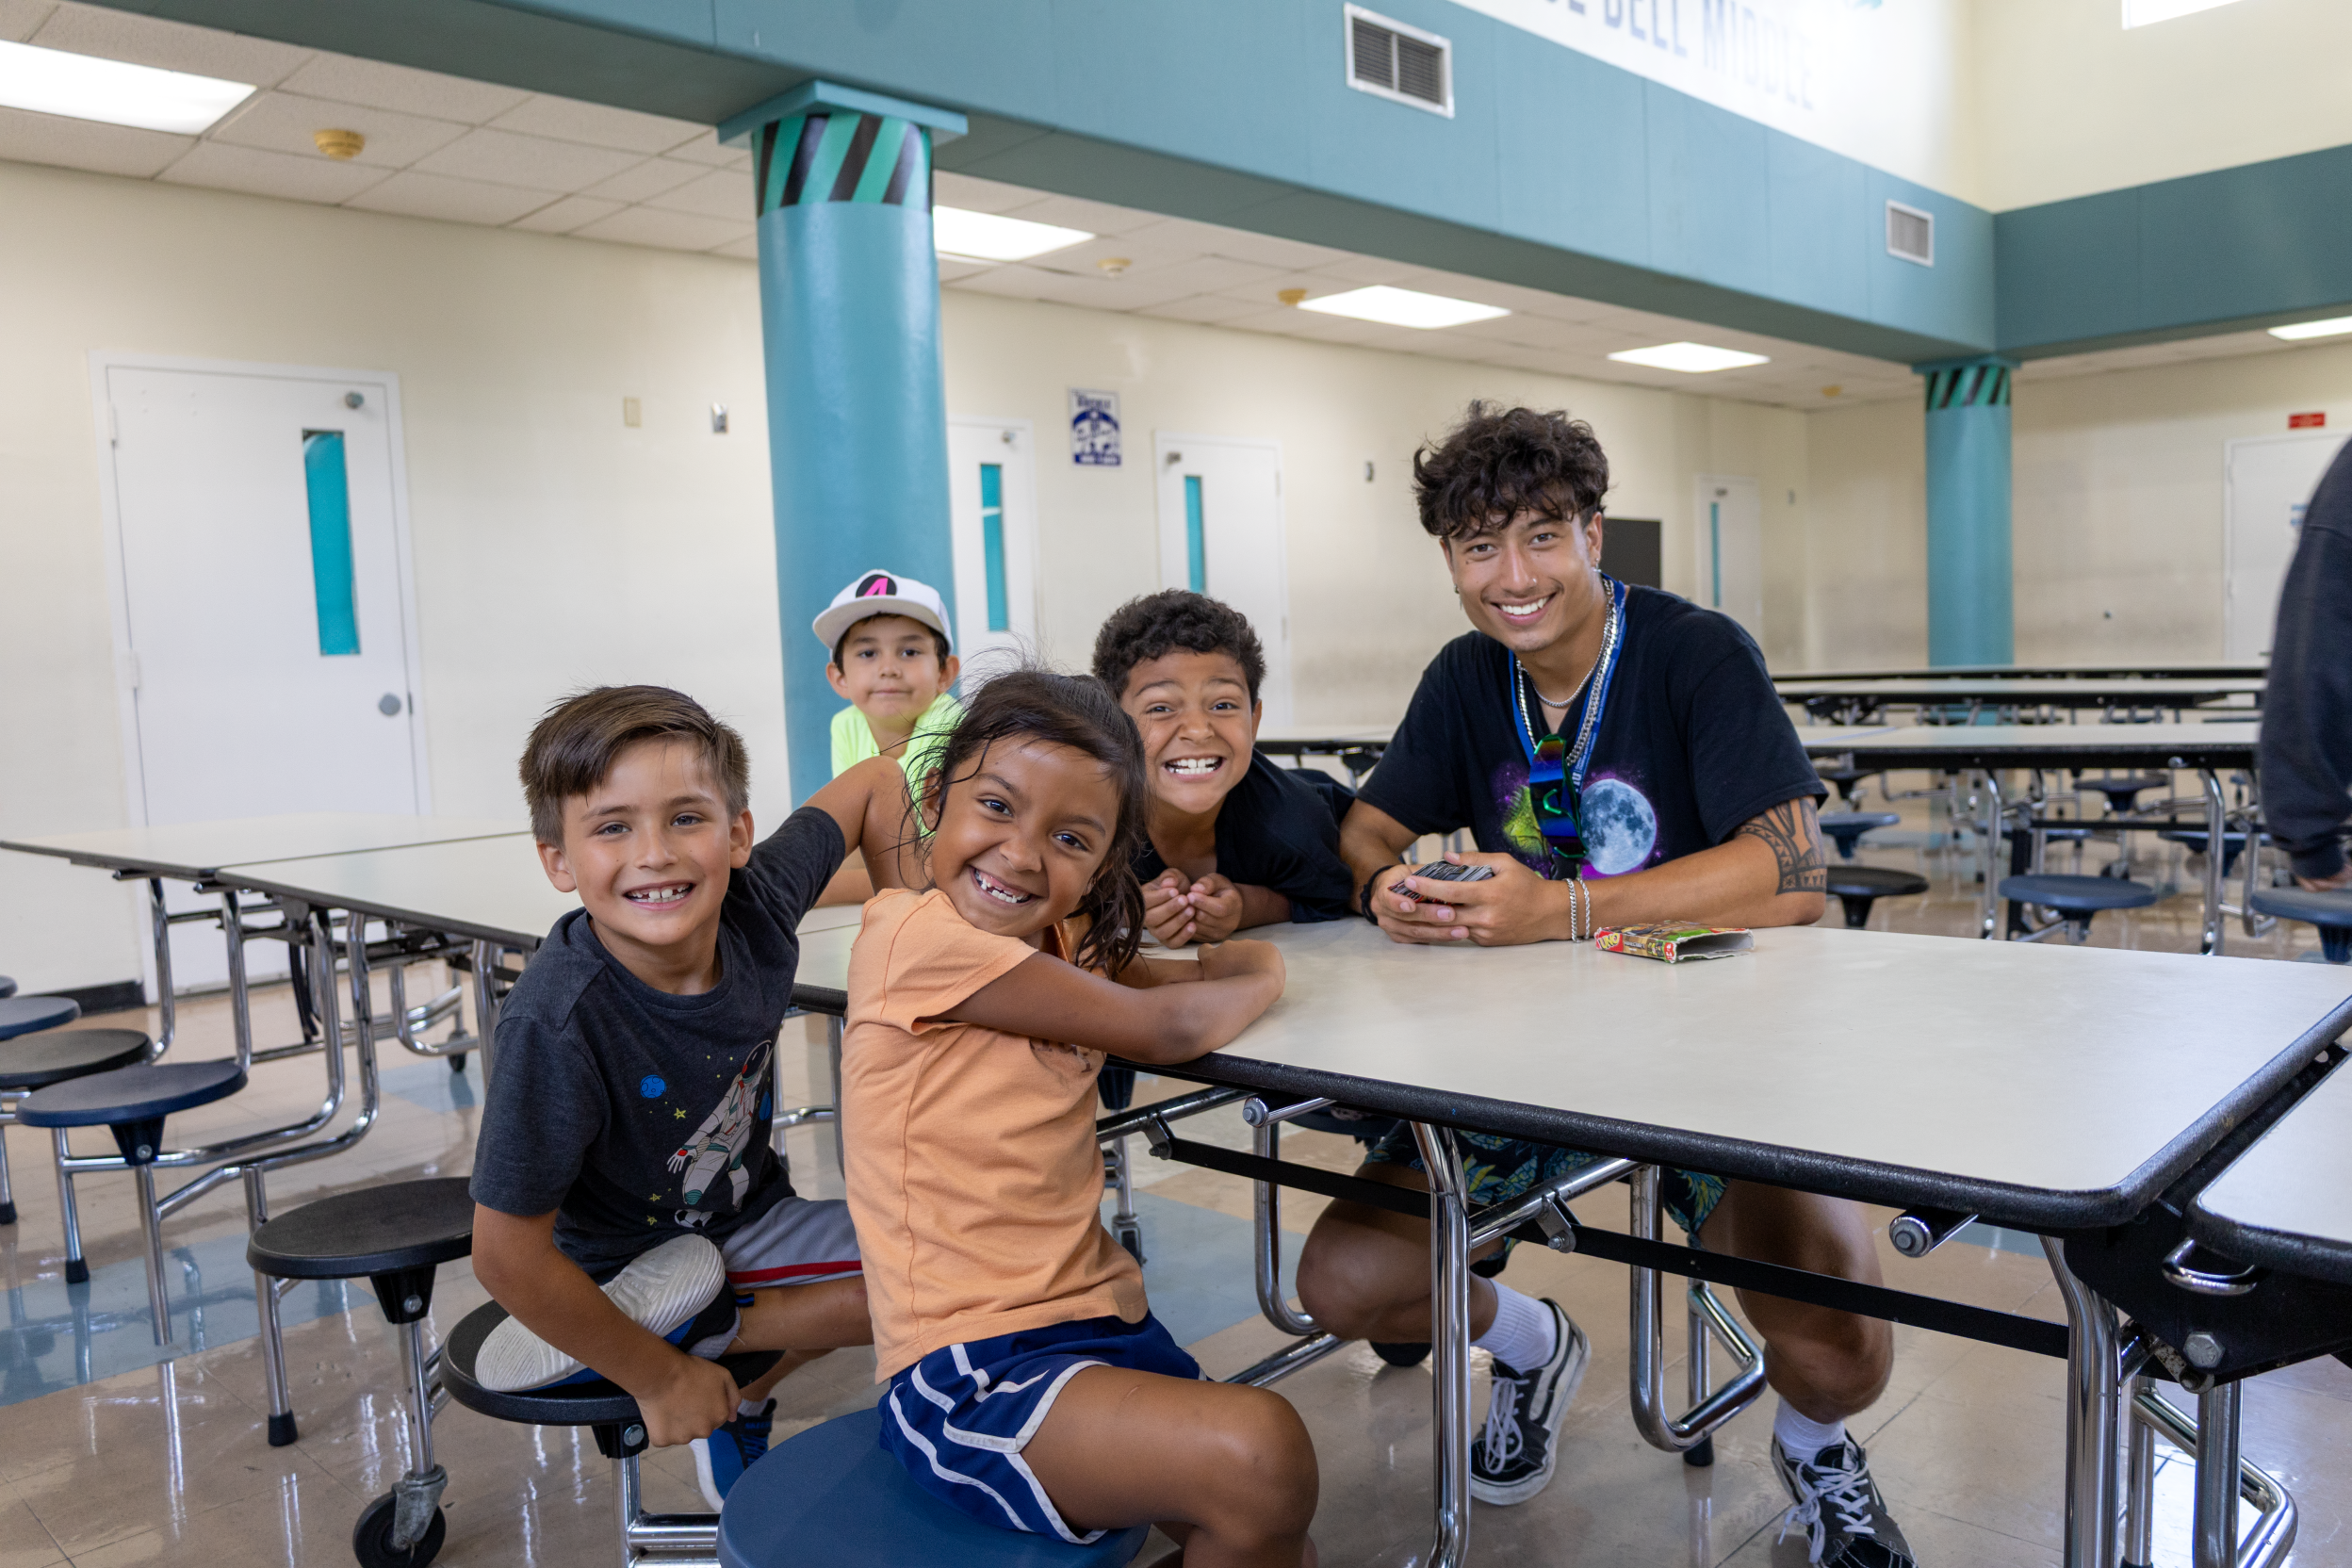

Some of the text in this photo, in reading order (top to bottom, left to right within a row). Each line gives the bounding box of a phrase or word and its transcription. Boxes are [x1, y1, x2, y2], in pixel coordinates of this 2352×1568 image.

[1703, 0, 1815, 111] MIDDLE
[1572, 772, 1582, 792] IU
[1598, 932, 1621, 950] UNO
